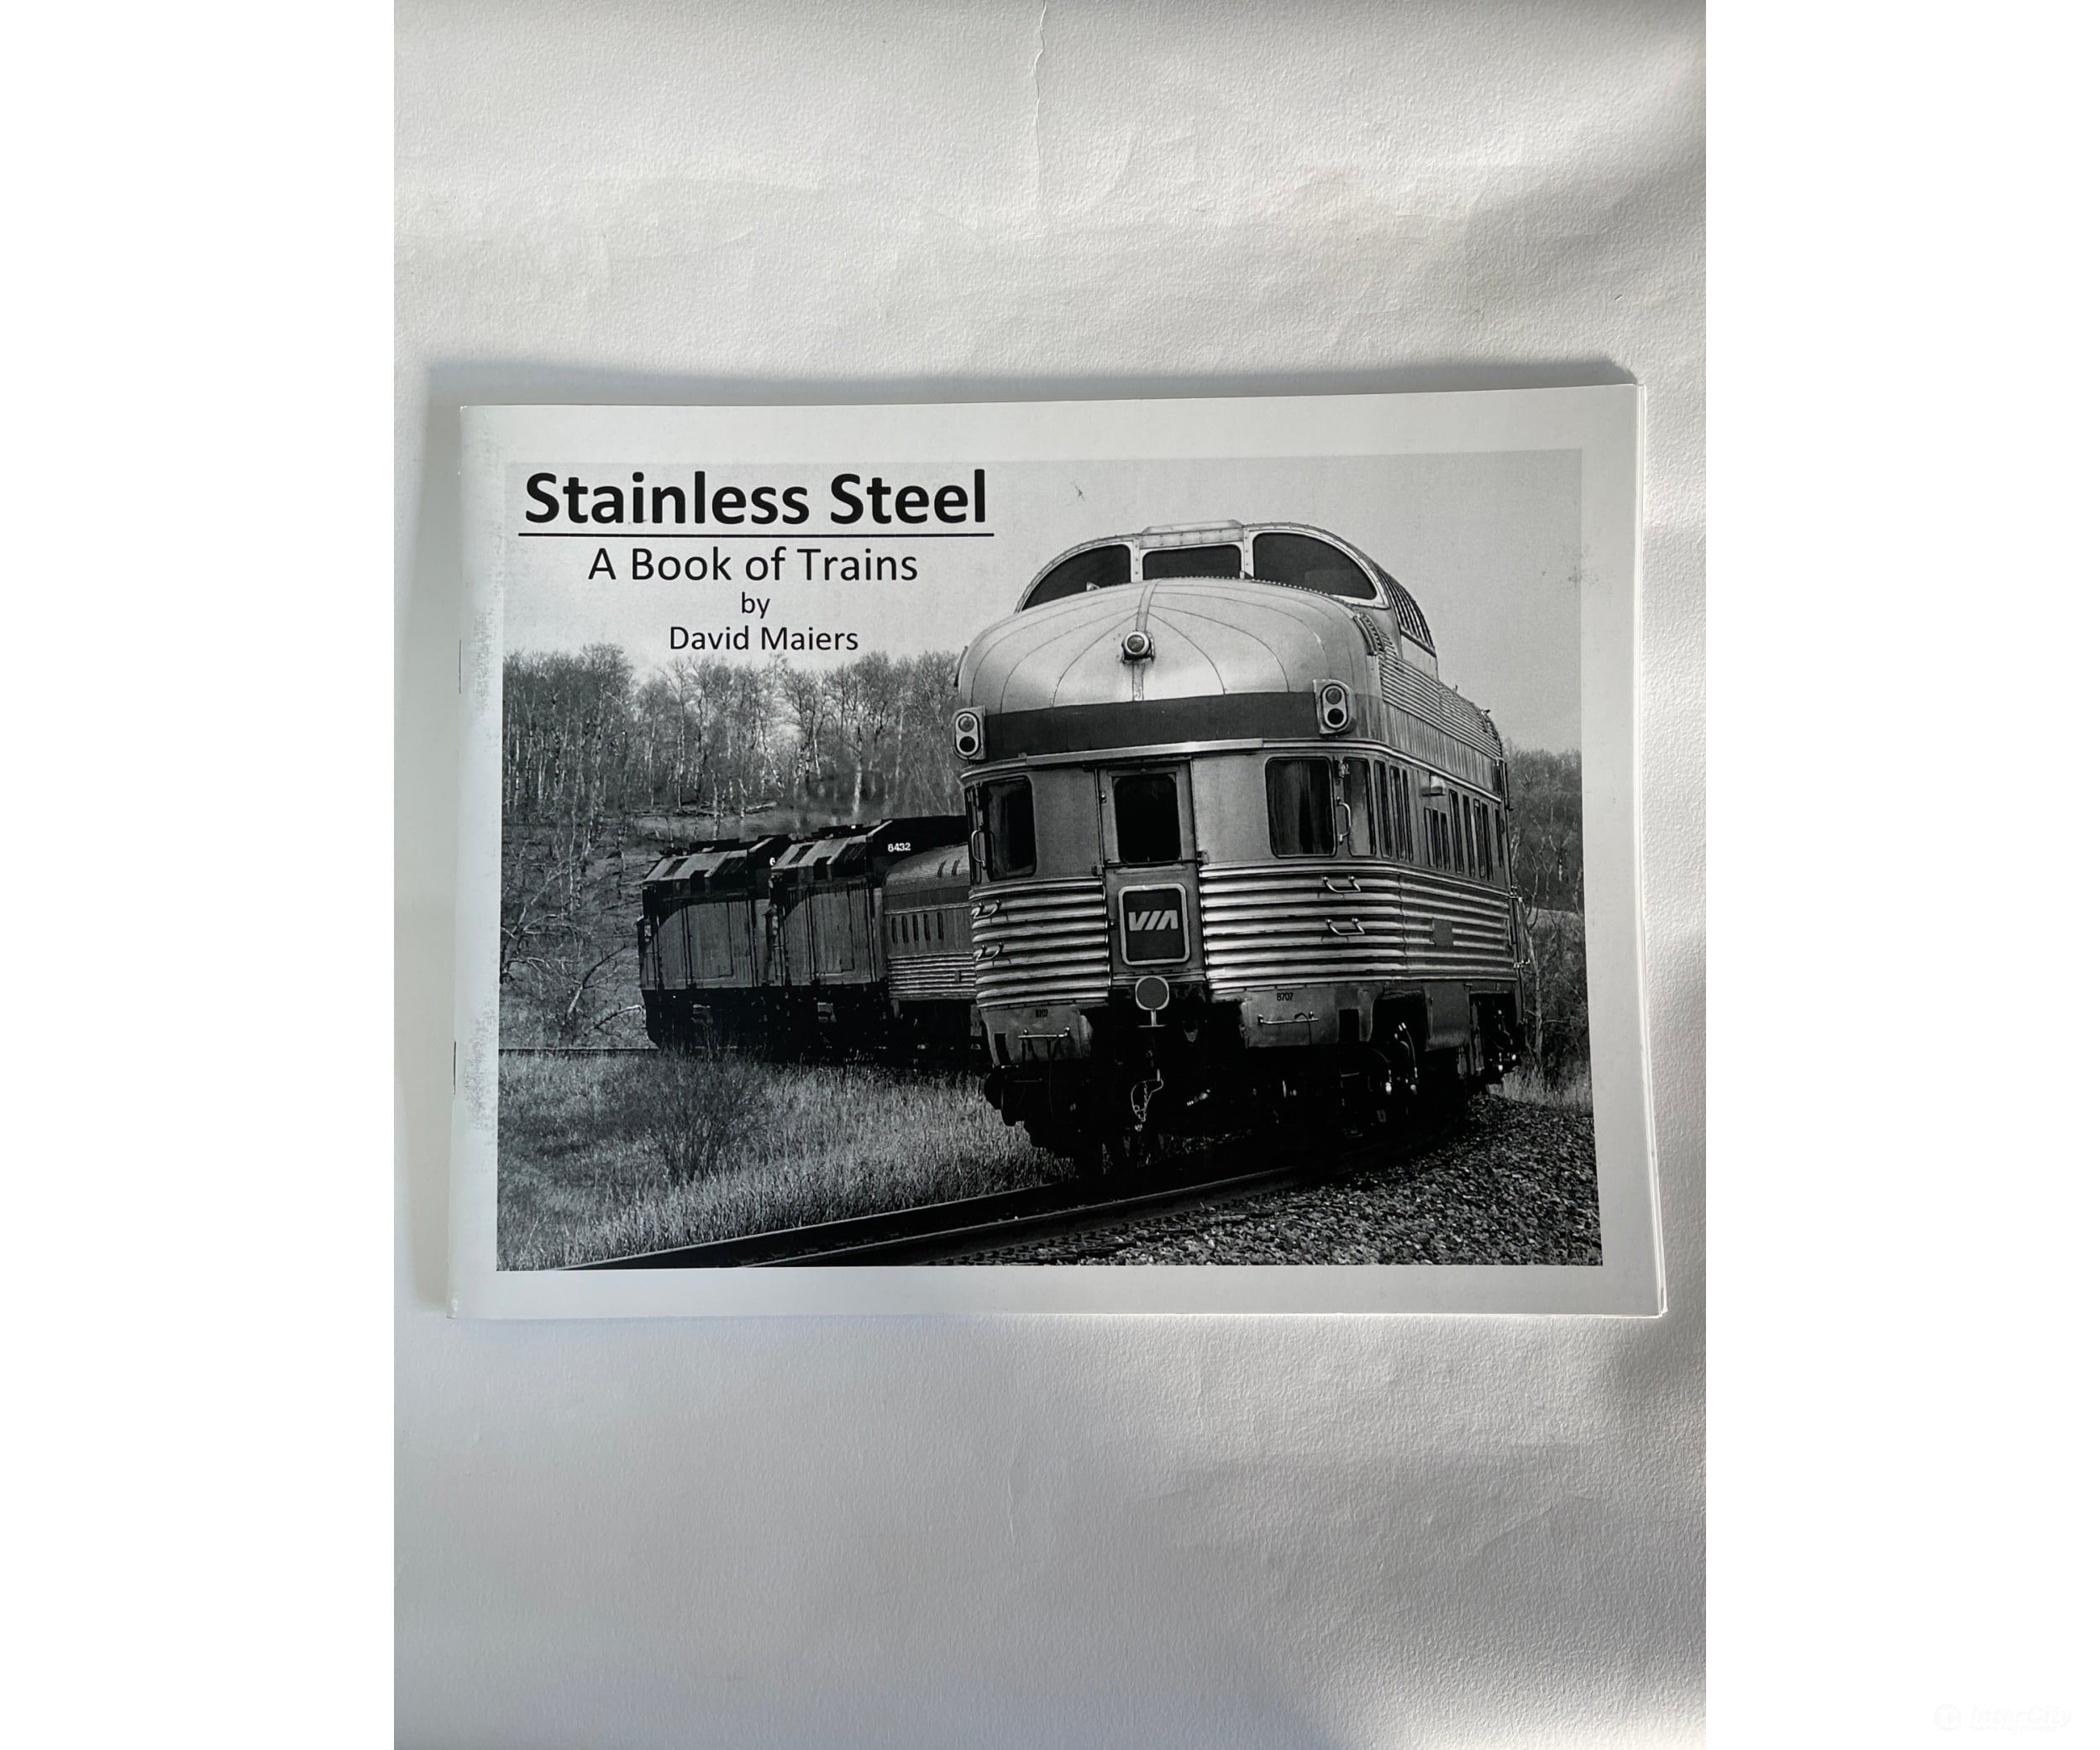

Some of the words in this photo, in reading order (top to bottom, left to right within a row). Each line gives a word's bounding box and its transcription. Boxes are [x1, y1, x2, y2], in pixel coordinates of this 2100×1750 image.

[525, 470, 810, 525] Stainless
[830, 468, 985, 525] Steel
[588, 548, 617, 580] A
[632, 546, 732, 581] Book
[745, 545, 787, 581] of
[796, 547, 918, 581] Trains
[741, 591, 770, 617] by
[669, 625, 749, 650] David
[761, 627, 858, 651] Maiers
[887, 842, 911, 853] 6432
[1128, 910, 1179, 932] VIA
